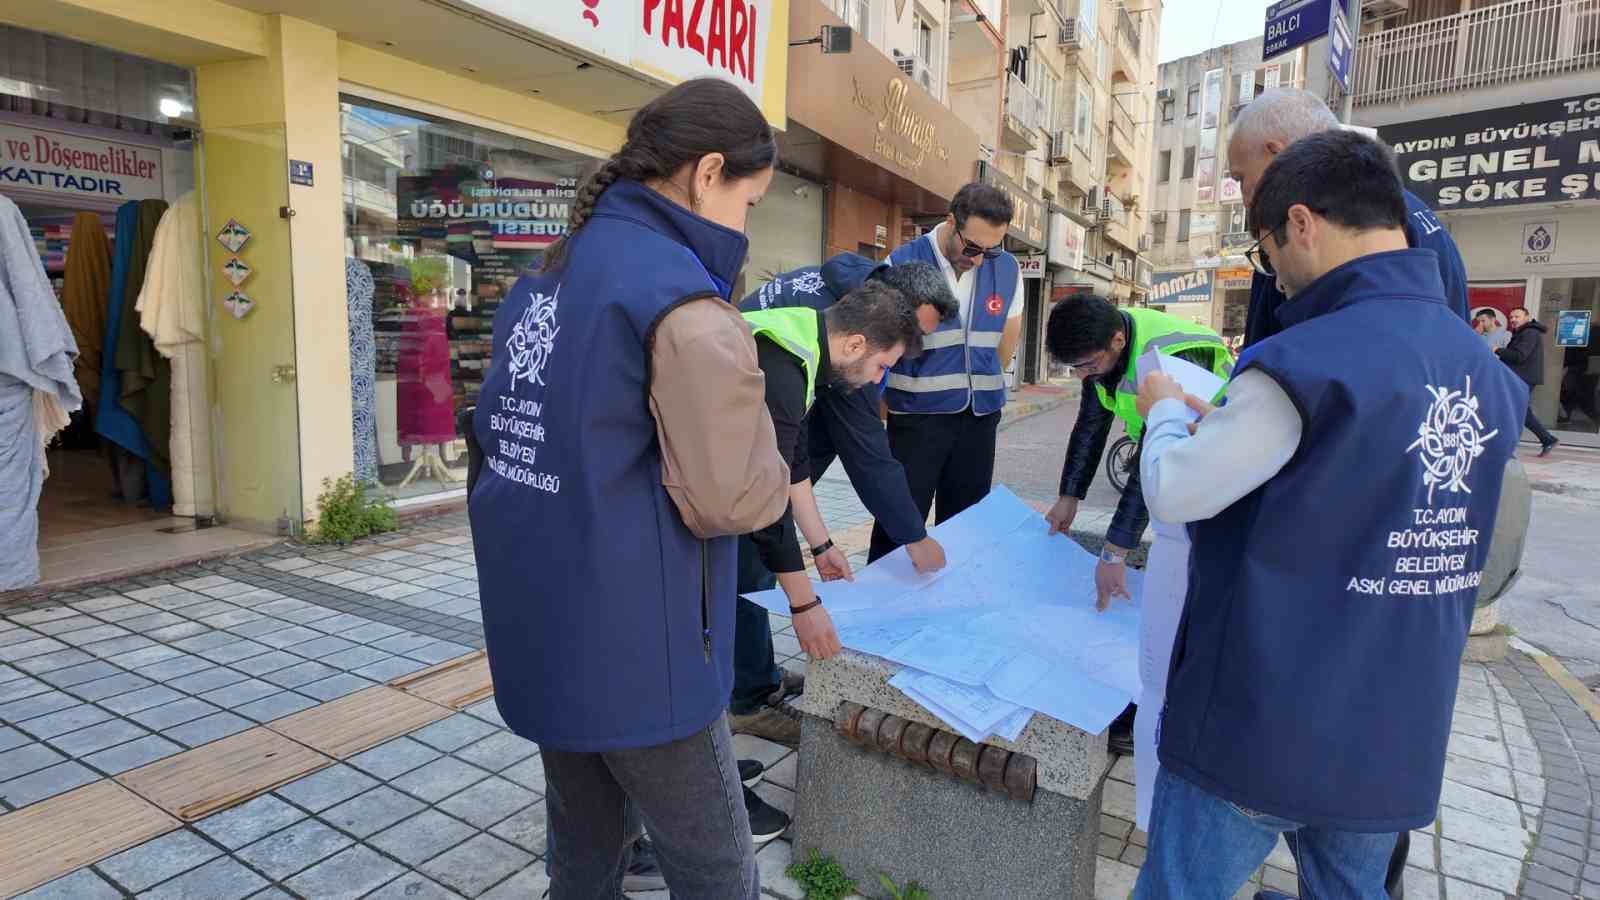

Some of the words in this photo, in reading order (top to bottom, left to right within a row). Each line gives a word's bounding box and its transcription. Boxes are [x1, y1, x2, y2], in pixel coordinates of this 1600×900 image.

[1268, 13, 1300, 41] BALCI
[1266, 38, 1288, 55] SOKAK
[6, 139, 31, 161] ve
[33, 135, 156, 179] Döşemelikler
[1394, 135, 1456, 154] AYDIN
[1408, 145, 1560, 182] GENEL
[1438, 178, 1547, 205] SÖKE
[1560, 172, 1600, 199] Ş
[490, 413, 545, 442] BÜYÜKŞEHİR
[506, 464, 560, 494] MÜDÜRLÜĞÜ
[1387, 526, 1479, 550] BÜYÜKŞEHİR
[1346, 577, 1386, 595] ASKİ
[1388, 579, 1433, 595] GENEL
